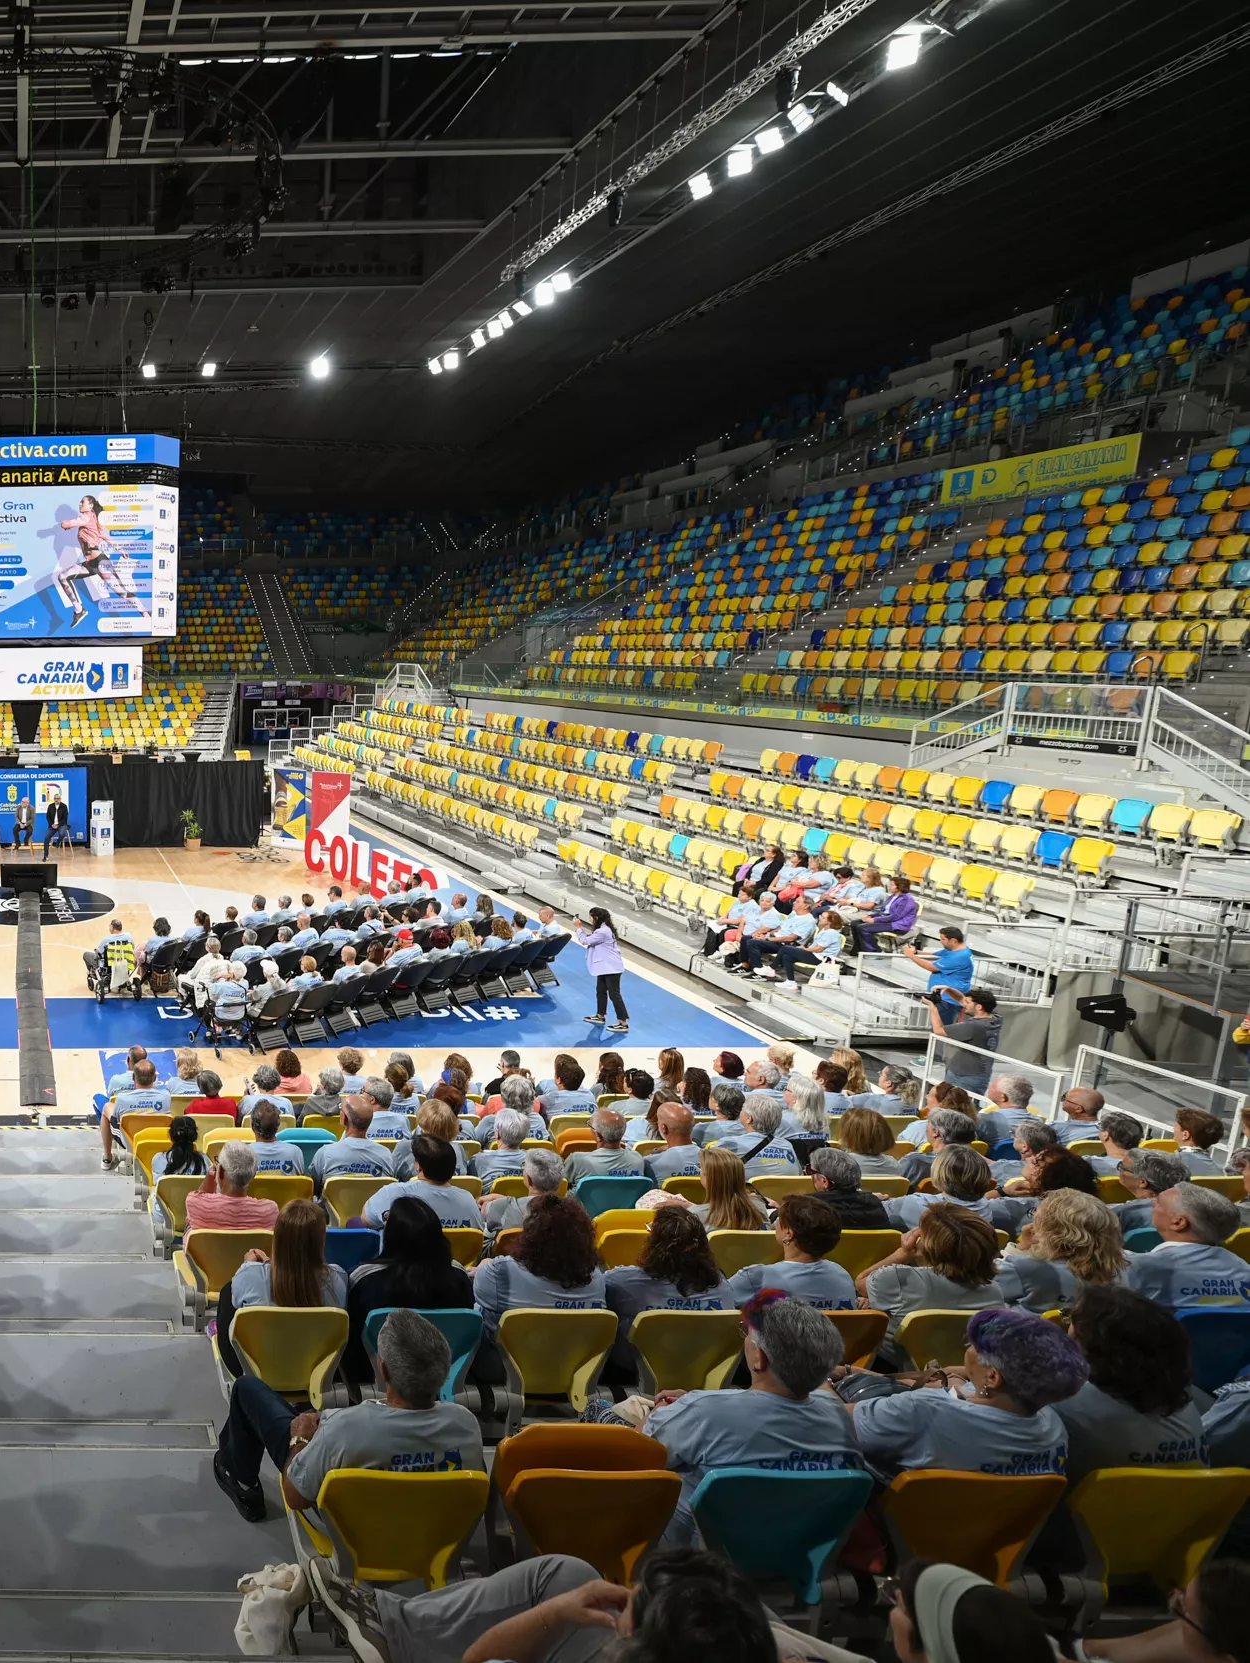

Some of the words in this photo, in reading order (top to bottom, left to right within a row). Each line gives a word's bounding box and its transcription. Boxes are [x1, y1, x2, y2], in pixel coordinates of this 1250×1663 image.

[1036, 453, 1073, 476] GRAN
[1071, 443, 1127, 470] CANARIA
[58, 467, 108, 482] Arena
[3, 501, 34, 511] Gran
[44, 661, 84, 672] GRAN
[17, 673, 84, 684] CANARIA
[31, 685, 84, 695] ACTIVA
[1039, 739, 1099, 751] mezzobespoke.com
[441, 1218, 459, 1226] RAN
[1202, 1279, 1235, 1288] GRAN
[1180, 1287, 1240, 1297] CANARIA
[554, 1301, 586, 1310] GRAN
[667, 1299, 700, 1308] GRAN
[1157, 1438, 1196, 1452] GRAN
[391, 1452, 435, 1465] GRAN
[790, 1451, 833, 1461] GRAN
[1011, 1452, 1050, 1463] GRAN
[1127, 1450, 1197, 1463] CANARIA
